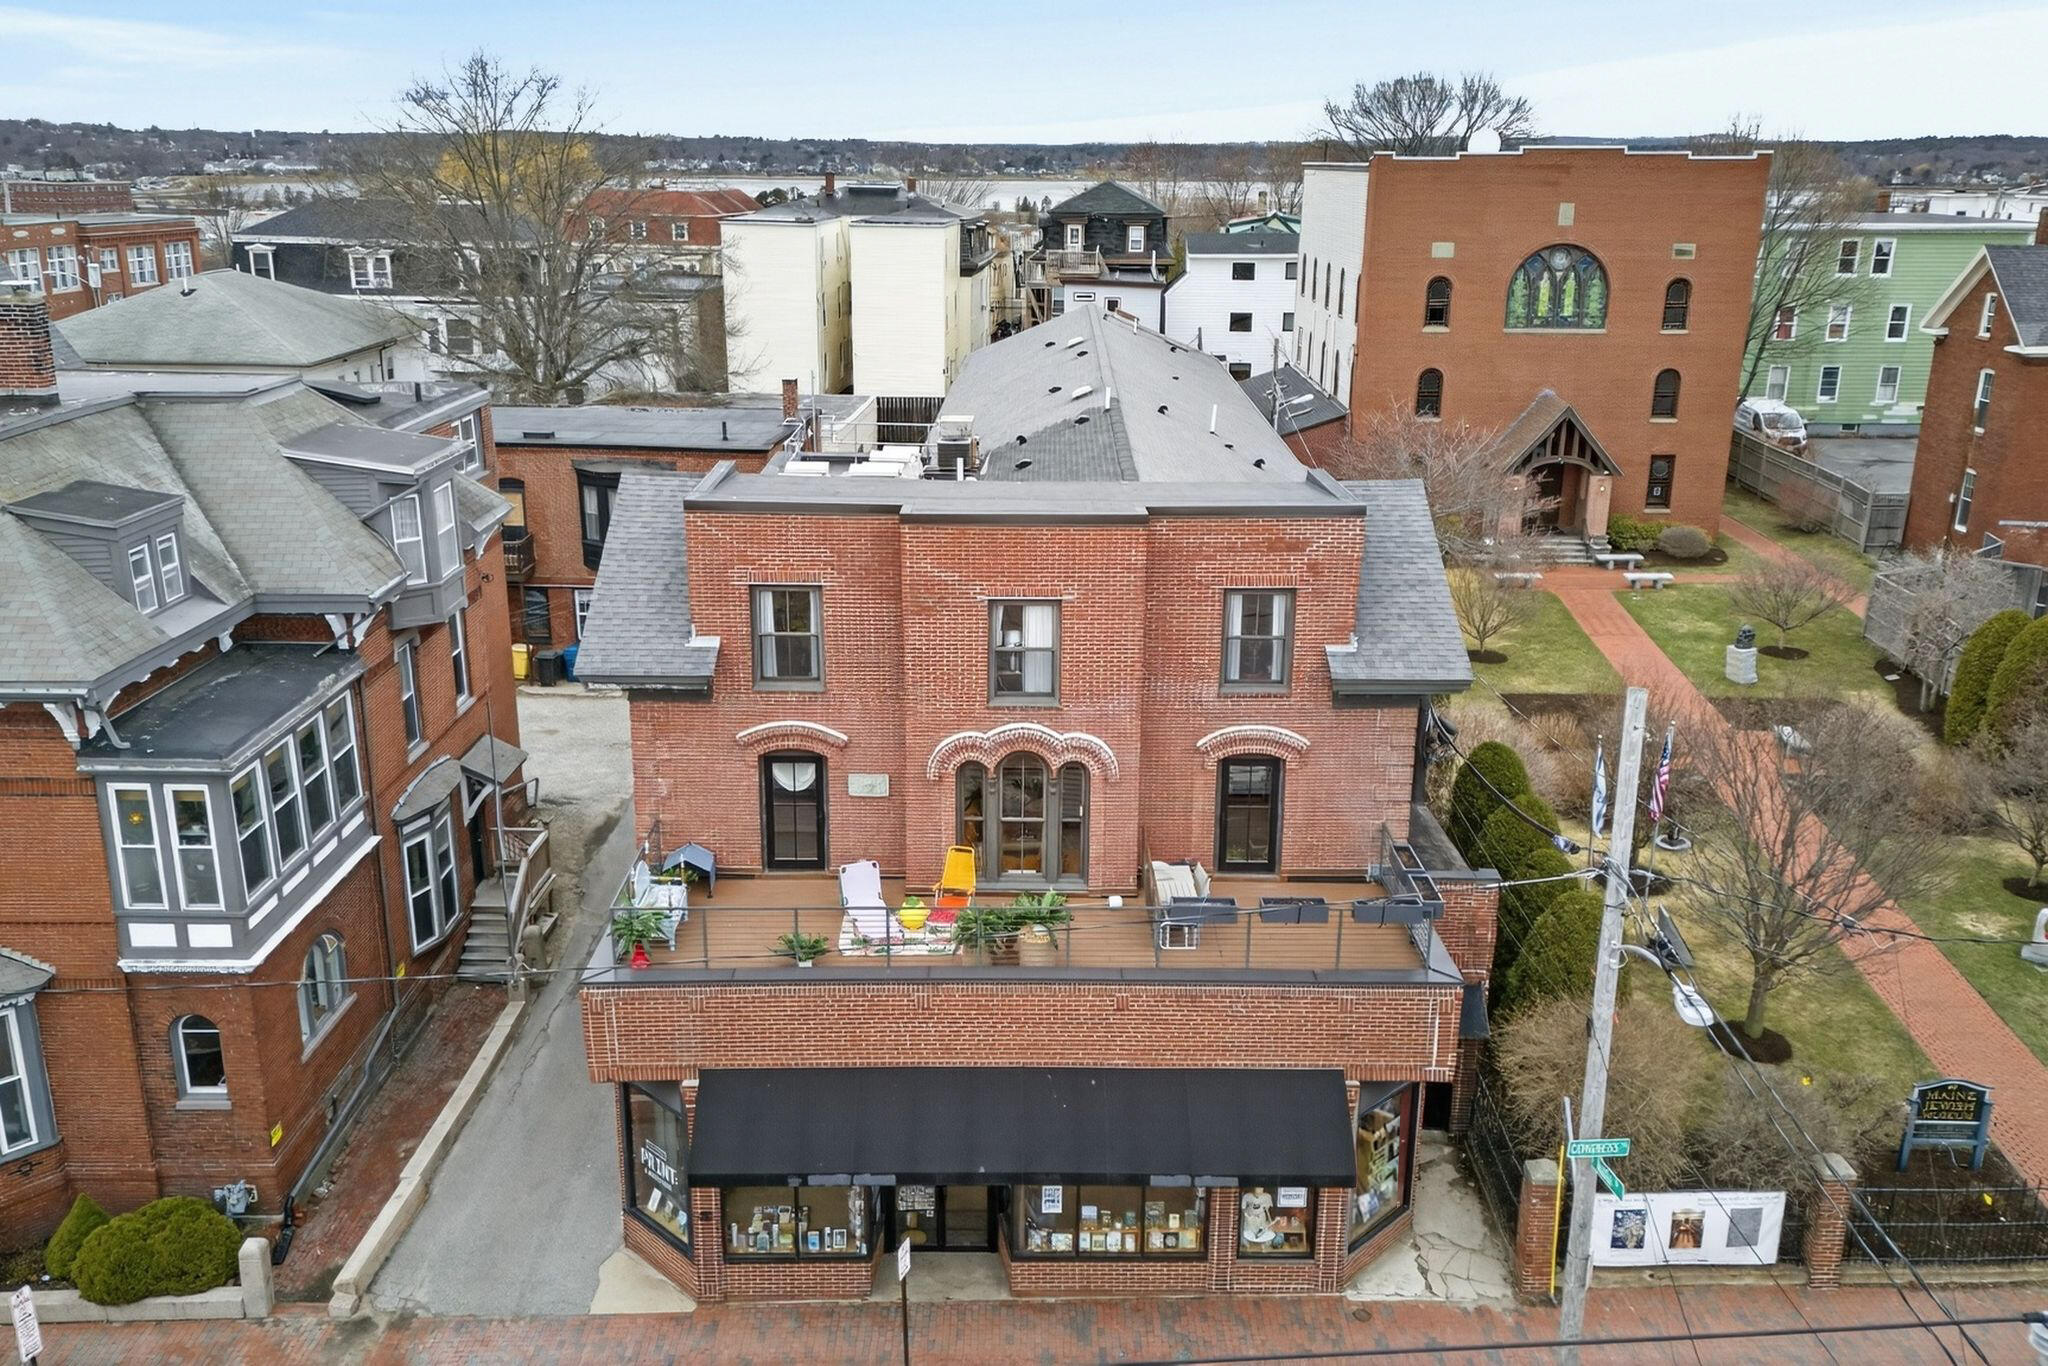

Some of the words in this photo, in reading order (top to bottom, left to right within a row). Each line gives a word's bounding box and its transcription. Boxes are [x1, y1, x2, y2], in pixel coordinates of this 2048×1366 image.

[1926, 1090, 1977, 1100] MAINE
[1922, 1100, 1976, 1111] JEWISH
[1571, 1142, 1618, 1154] CONGRESS
